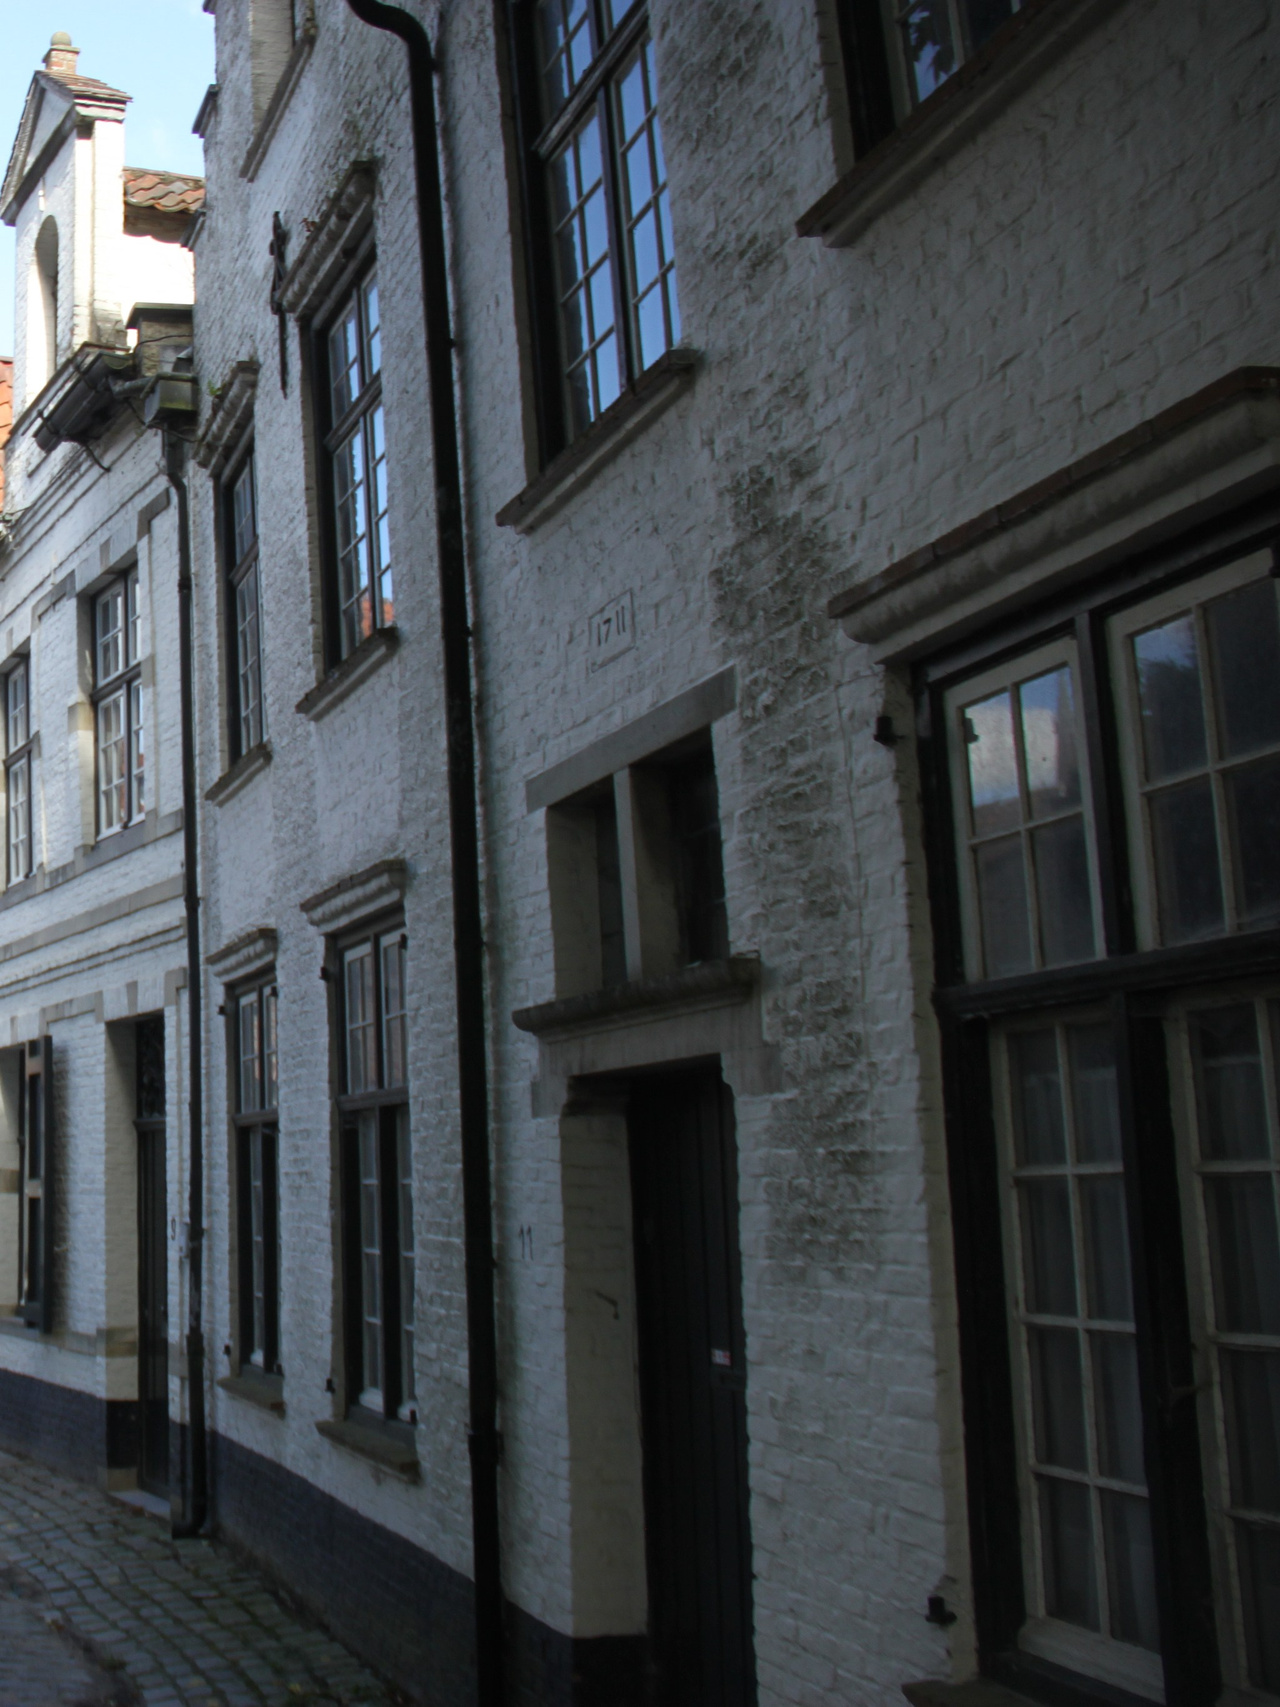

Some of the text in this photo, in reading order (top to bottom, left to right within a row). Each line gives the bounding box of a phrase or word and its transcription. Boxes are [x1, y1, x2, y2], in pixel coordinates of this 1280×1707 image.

[596, 605, 626, 647] 1711
[170, 1216, 177, 1241] 9
[518, 1224, 534, 1261] 11
